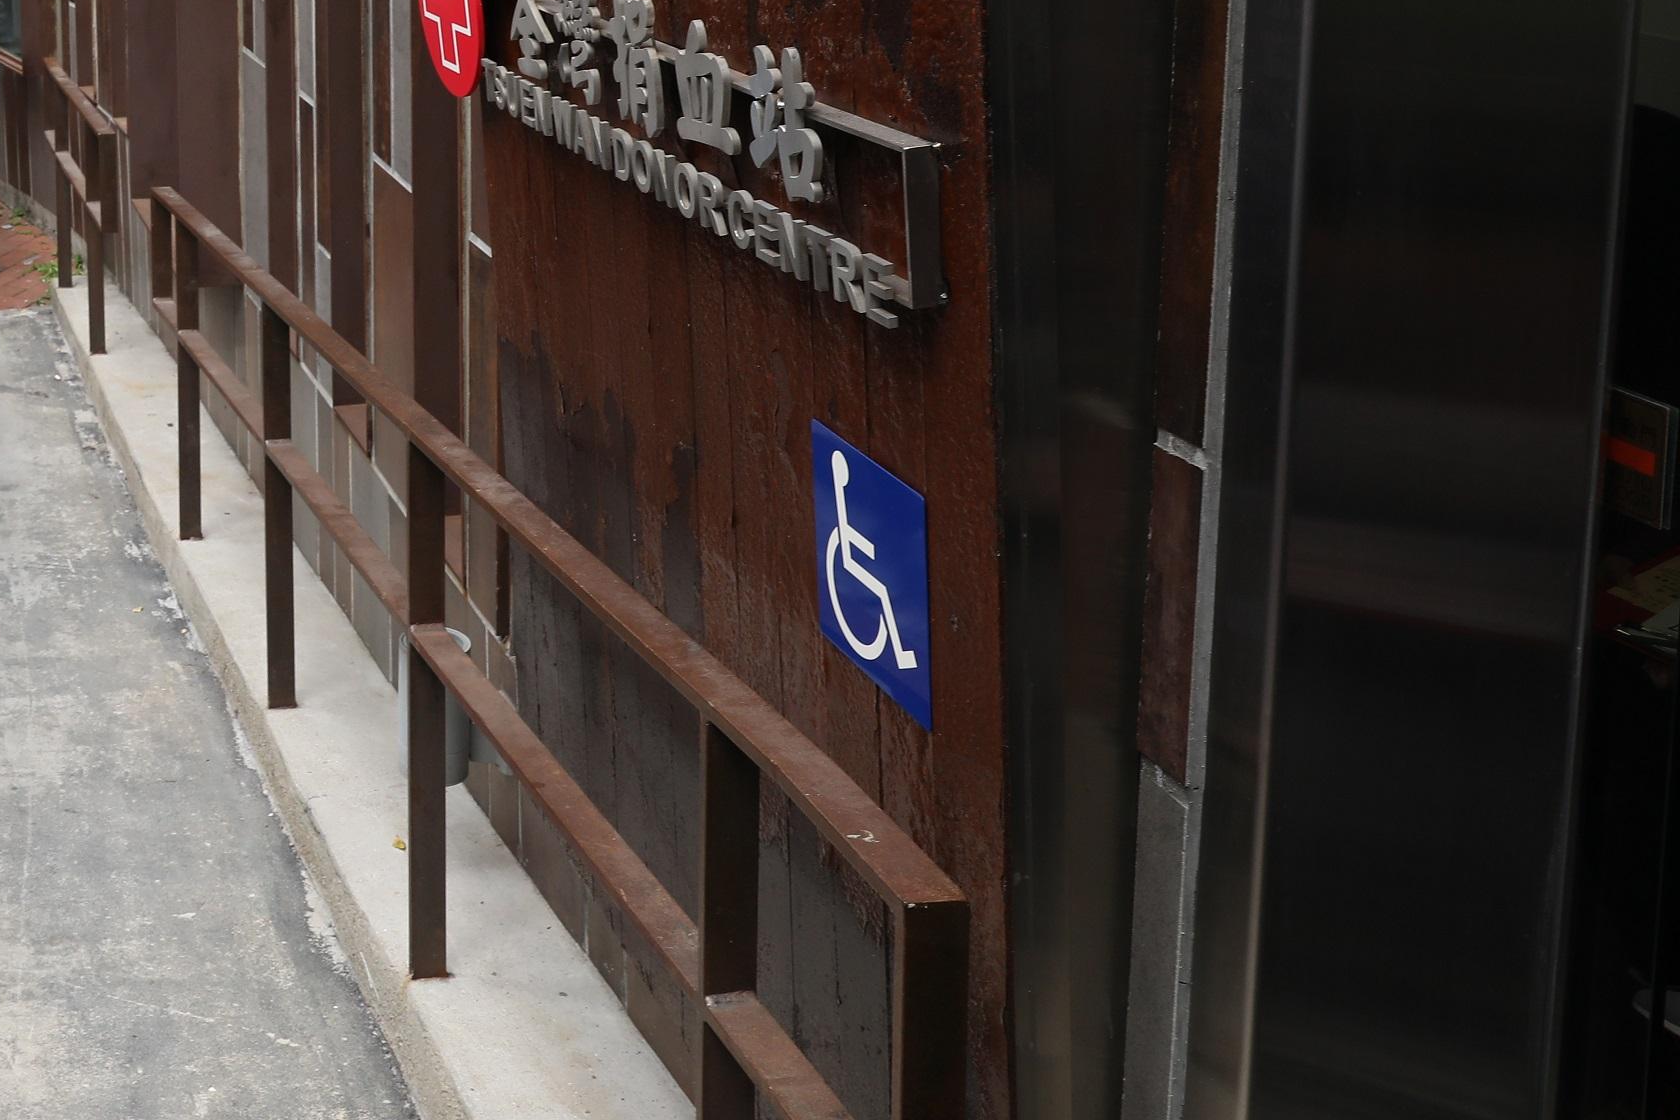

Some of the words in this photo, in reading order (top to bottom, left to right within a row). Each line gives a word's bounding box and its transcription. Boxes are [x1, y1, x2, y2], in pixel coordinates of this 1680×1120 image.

[482, 58, 554, 136] TSUEN
[552, 96, 613, 170] WAN
[610, 127, 729, 236] DONOR
[728, 190, 899, 329] CENTRE
